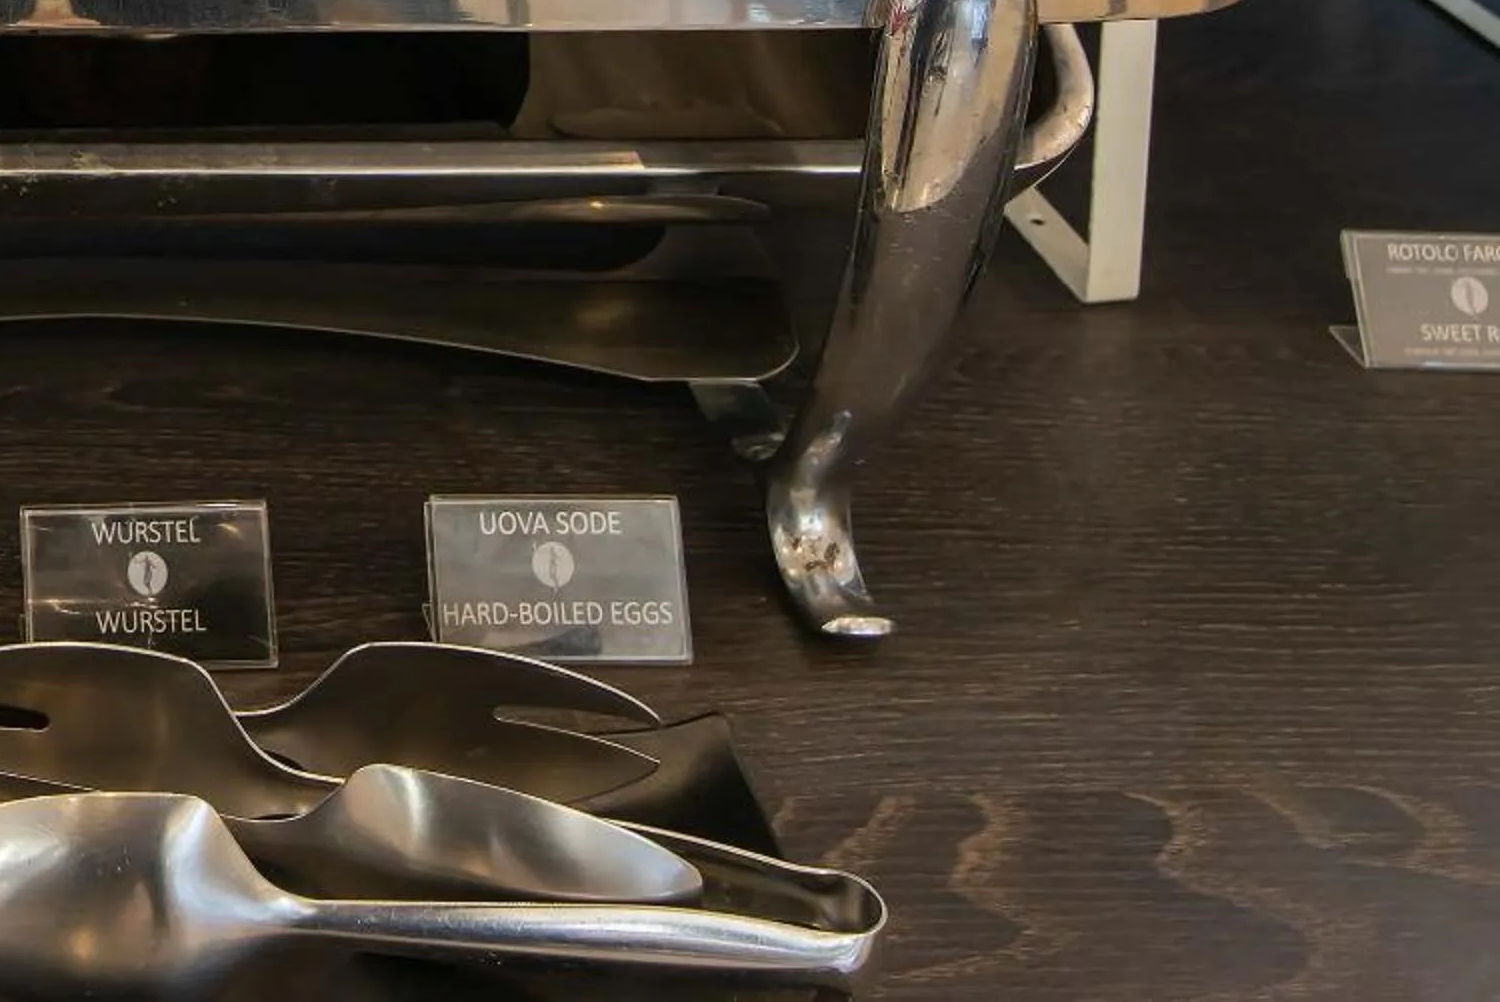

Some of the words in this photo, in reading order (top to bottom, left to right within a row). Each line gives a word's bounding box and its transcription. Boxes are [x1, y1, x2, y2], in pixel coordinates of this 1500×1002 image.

[1386, 243, 1459, 262] ROTOLO
[1419, 324, 1481, 343] SWEET
[91, 519, 201, 545] WURSTEL
[479, 511, 550, 536] UOVA
[556, 511, 622, 535] SODE
[96, 609, 207, 634] WURSTEL
[443, 601, 602, 626] HARD-BOILED
[611, 601, 673, 625] EGGS
